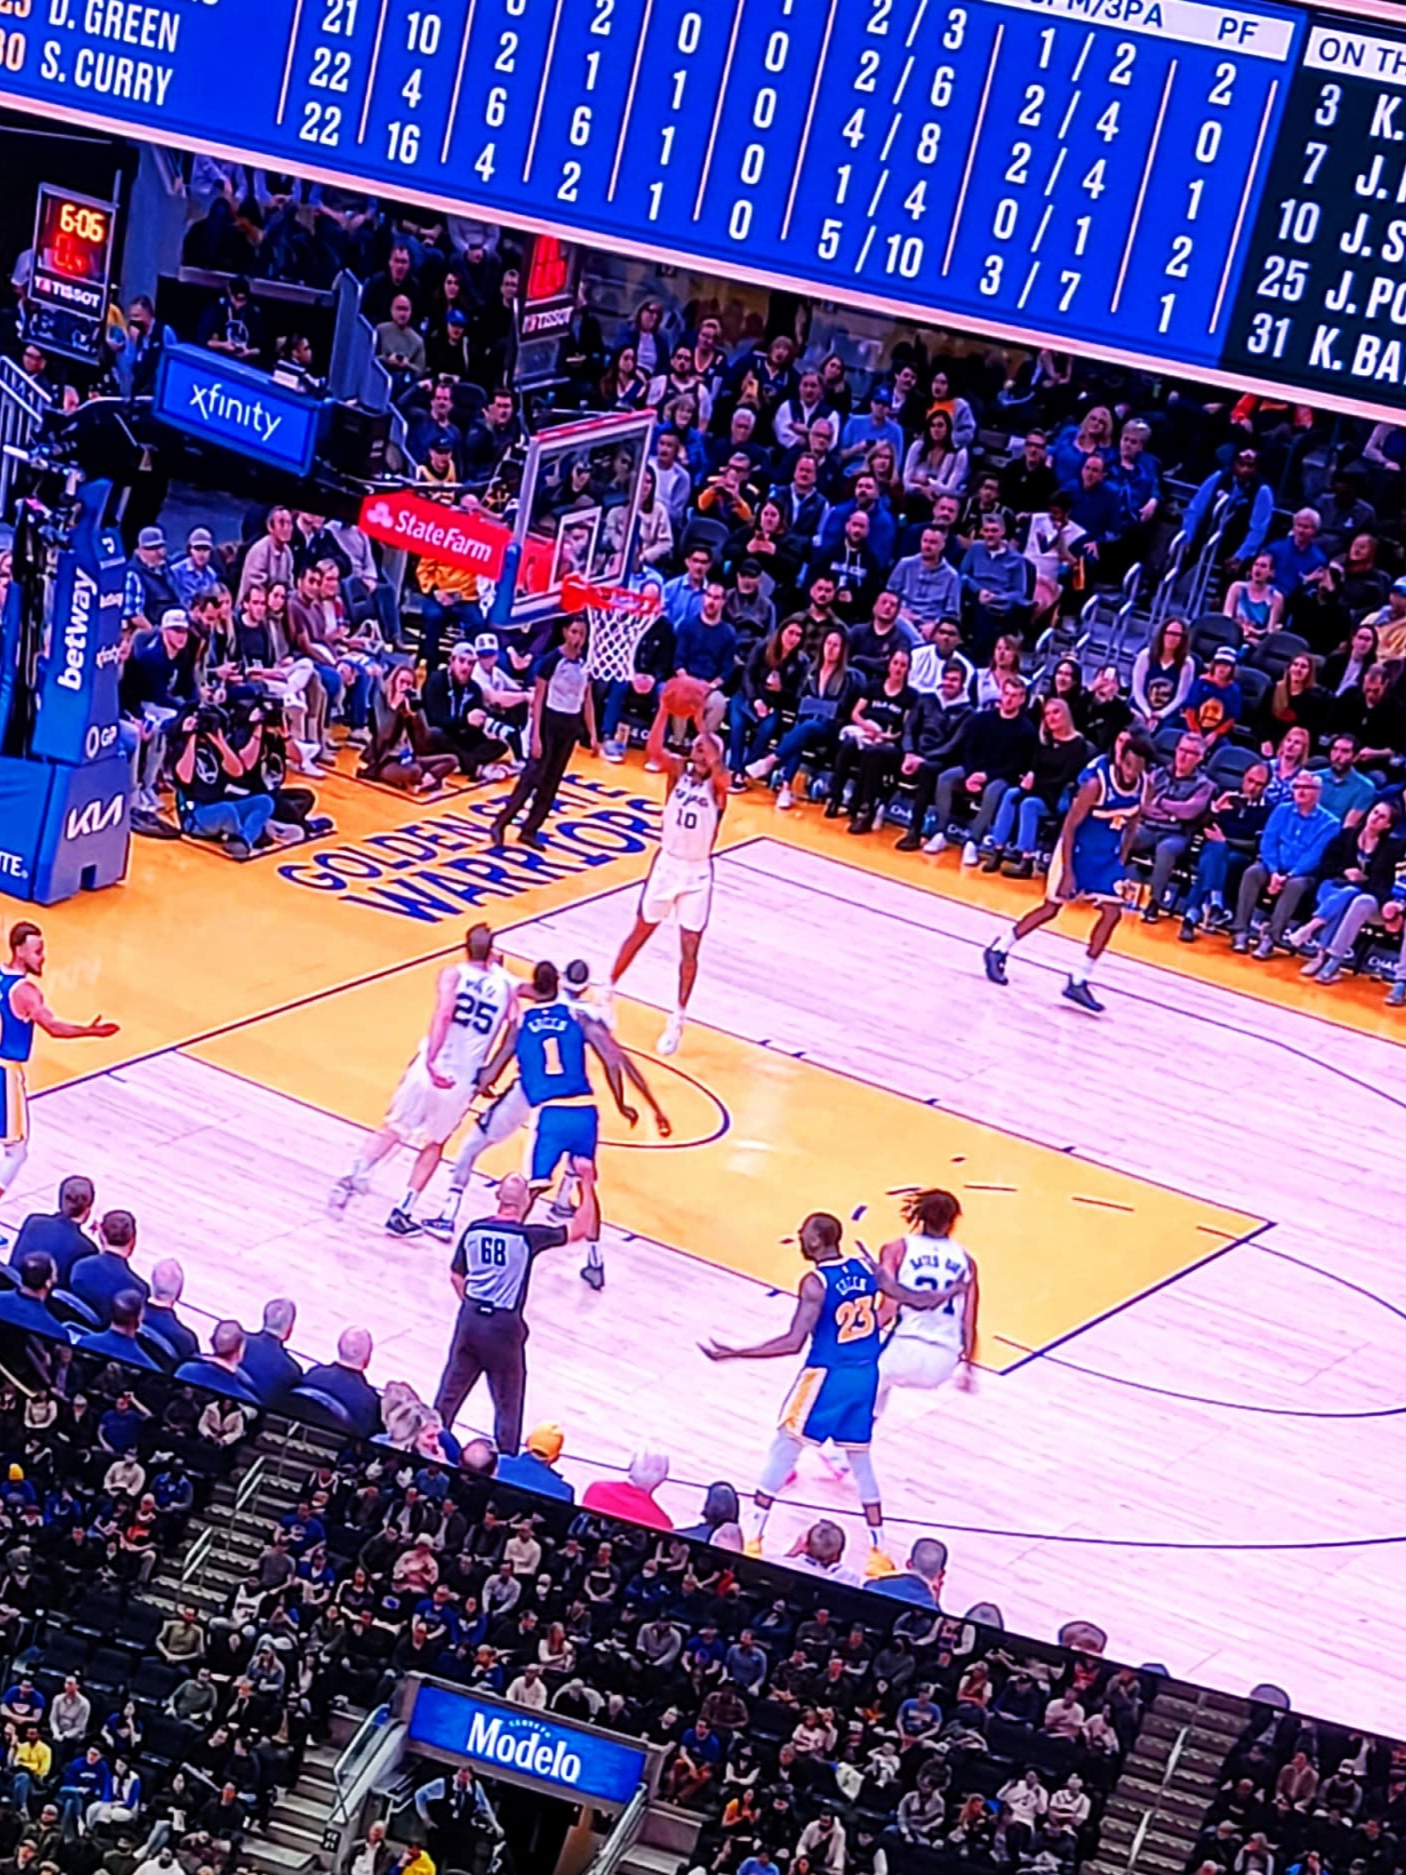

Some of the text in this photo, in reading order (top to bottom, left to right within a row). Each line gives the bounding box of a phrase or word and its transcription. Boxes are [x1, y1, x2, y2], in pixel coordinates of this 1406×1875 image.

[867, 0, 892, 34] 2
[944, 9, 966, 49] 3
[1040, 29, 1054, 68] 1
[1109, 43, 1135, 85] 2
[1209, 63, 1236, 105] 2
[1217, 17, 1260, 44] PF
[1319, 37, 1366, 67] ON
[322, 0, 358, 36] 21
[407, 12, 441, 54] 10
[495, 32, 517, 72] 2
[587, 52, 599, 90] 1
[673, 71, 686, 109] 1
[754, 88, 776, 127] 0
[843, 109, 864, 147] 4
[917, 123, 940, 163] 8
[1006, 143, 1031, 183] 2
[1083, 160, 1105, 198] 4
[1188, 180, 1203, 219] 1
[590, 0, 614, 36] 2
[679, 13, 701, 53] 0
[766, 32, 788, 71] 0
[855, 51, 879, 91] 2
[931, 67, 954, 106] 6
[1019, 85, 1044, 126] 2
[1097, 102, 1119, 141] 4
[1196, 121, 1221, 162] 0
[49, 0, 75, 29] D.
[84, 0, 181, 53] GREEN
[309, 48, 351, 91] 22
[403, 69, 421, 107] 4
[486, 88, 506, 126] 6
[571, 106, 591, 145] 6
[661, 127, 674, 164] 1
[741, 144, 764, 184] 0
[837, 165, 850, 203] 1
[905, 181, 926, 219] 4
[994, 199, 1017, 239] 0
[1076, 217, 1090, 255] 1
[1166, 236, 1192, 277] 2
[1315, 84, 1403, 141] 3 K.
[40, 40, 66, 83] S.
[75, 48, 173, 106] CURRY
[300, 102, 342, 146] 22
[388, 122, 420, 163] 16
[475, 144, 494, 181] 4
[558, 162, 580, 201] 2
[650, 183, 662, 220] 1
[730, 200, 752, 239] 0
[819, 219, 842, 259] 5
[887, 235, 923, 277] 10
[981, 255, 1003, 294] 3
[1060, 271, 1080, 311] 7
[1160, 294, 1174, 332] 1
[1303, 141, 1328, 184] 7
[1355, 154, 1388, 200] J.
[1278, 199, 1320, 244] 10
[1340, 213, 1372, 257] J.
[1256, 255, 1309, 302] 25
[1325, 271, 1357, 315] J.
[1247, 312, 1406, 384] 31 K. BA
[189, 383, 282, 442] xfinity
[57, 566, 98, 692] betway
[278, 811, 492, 891] GOLDEN
[451, 992, 499, 1035] 25
[542, 1036, 565, 1075] 1
[480, 1236, 506, 1267] 68
[834, 1296, 876, 1344] 23
[465, 1711, 583, 1784] Modelo
